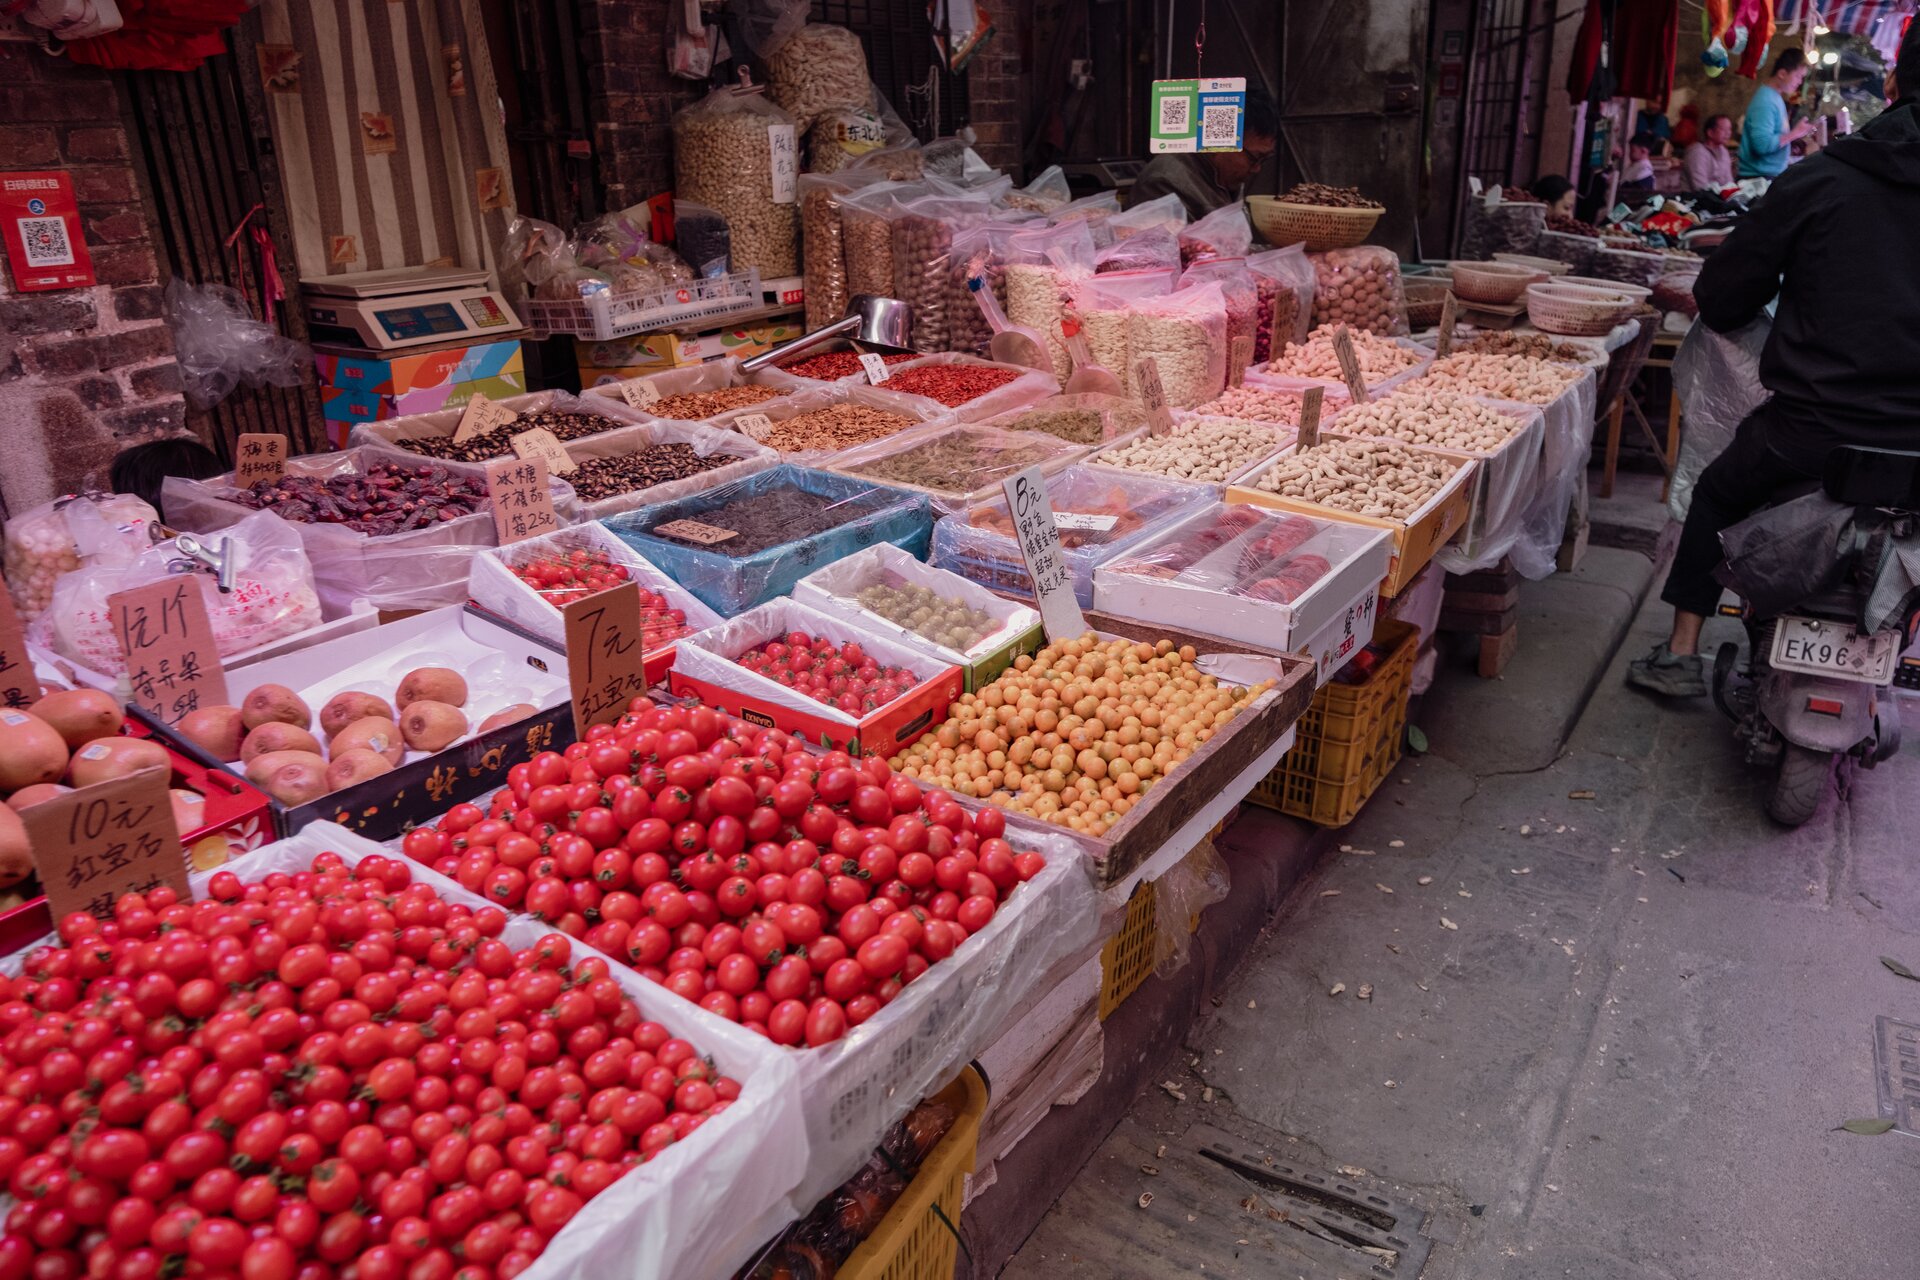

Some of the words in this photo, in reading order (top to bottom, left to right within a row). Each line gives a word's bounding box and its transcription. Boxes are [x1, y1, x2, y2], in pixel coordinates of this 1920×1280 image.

[578, 607, 636, 684] 7元
[69, 798, 154, 846] 10元
[66, 832, 163, 890] 红宝石
